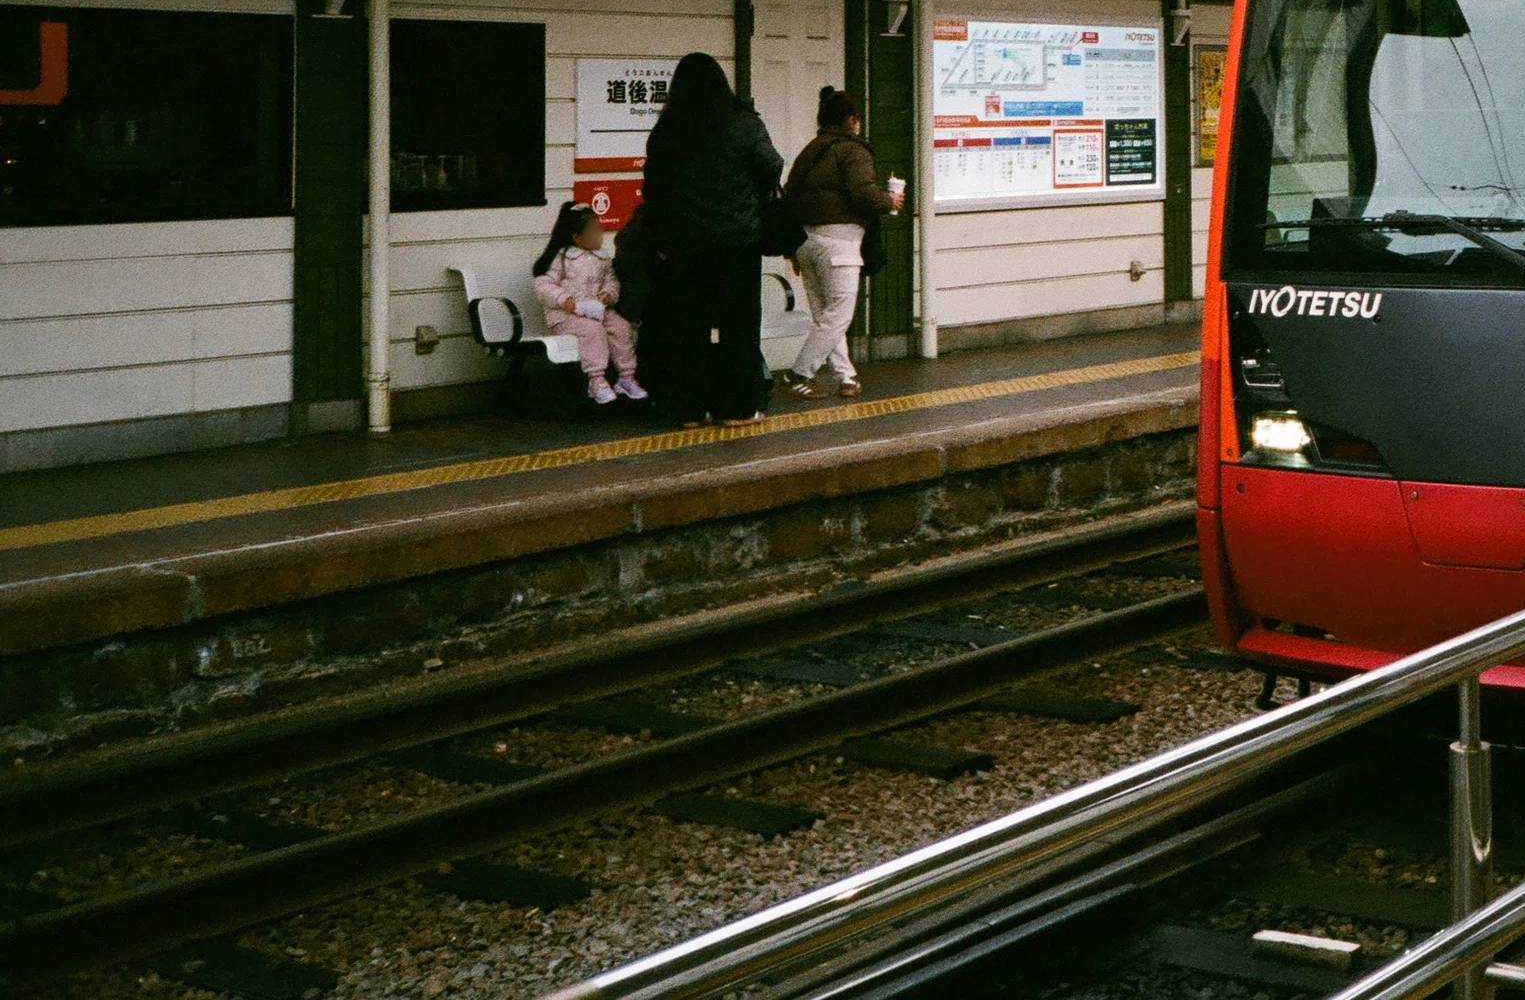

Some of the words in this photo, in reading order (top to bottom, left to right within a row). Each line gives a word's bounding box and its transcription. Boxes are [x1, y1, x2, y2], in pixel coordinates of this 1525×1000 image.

[606, 80, 669, 104] 道後温
[1249, 285, 1382, 318] IYOTETSU
